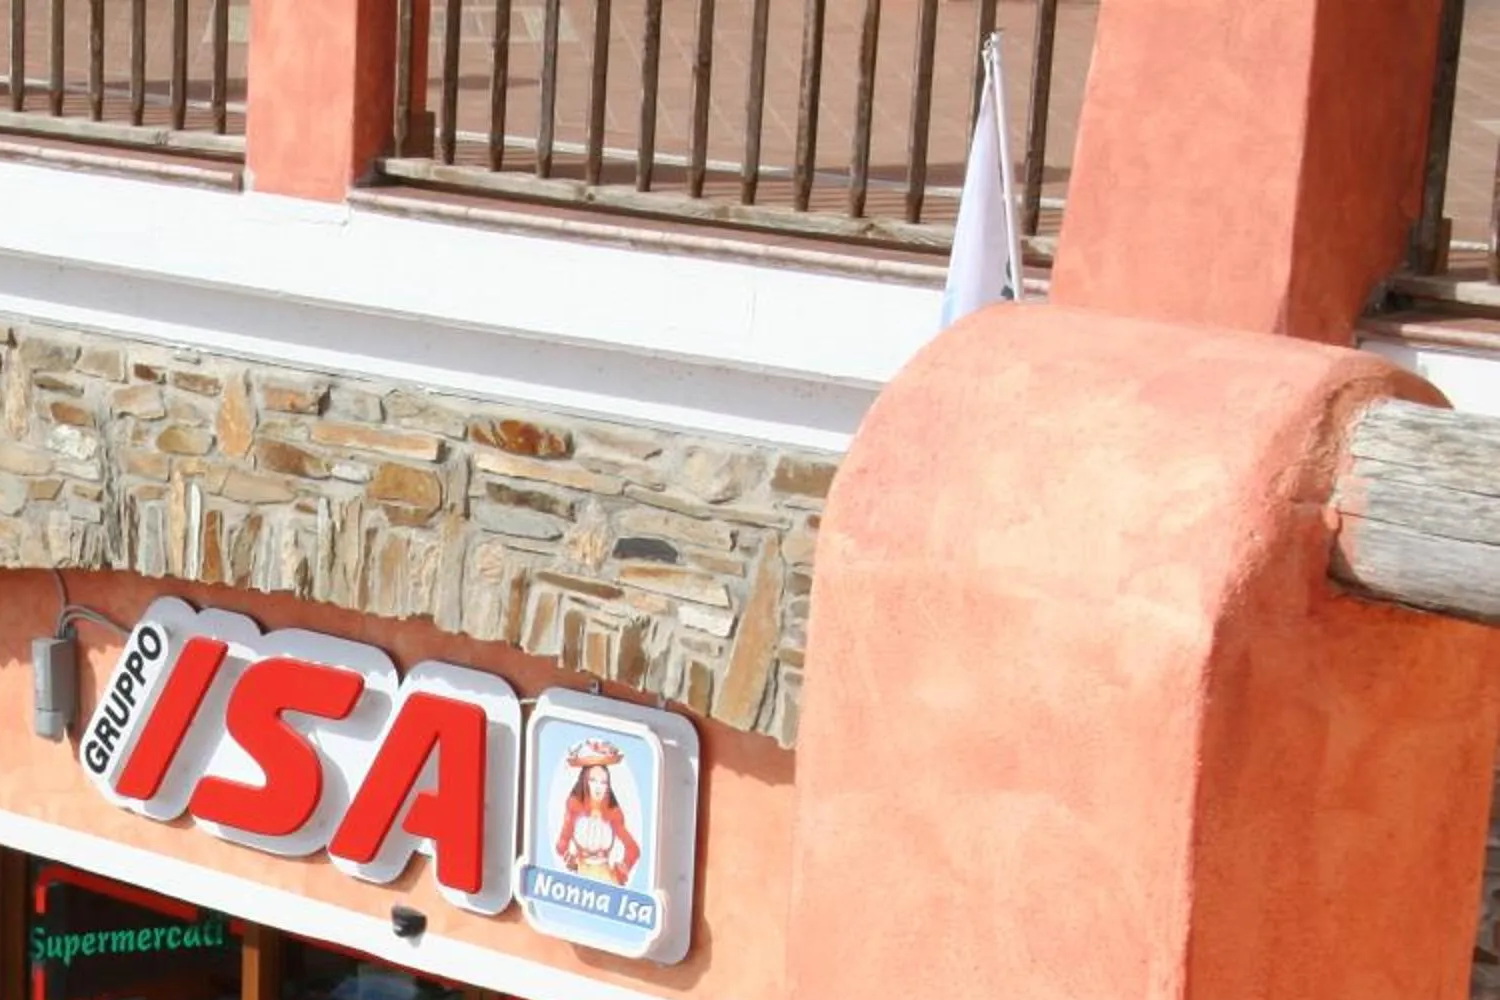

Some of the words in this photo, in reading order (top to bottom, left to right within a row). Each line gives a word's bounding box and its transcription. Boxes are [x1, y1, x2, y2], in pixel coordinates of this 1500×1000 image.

[83, 623, 164, 777] GRUPPO
[114, 634, 489, 896] ISA
[533, 871, 611, 914] Nonna
[617, 893, 654, 926] Isa
